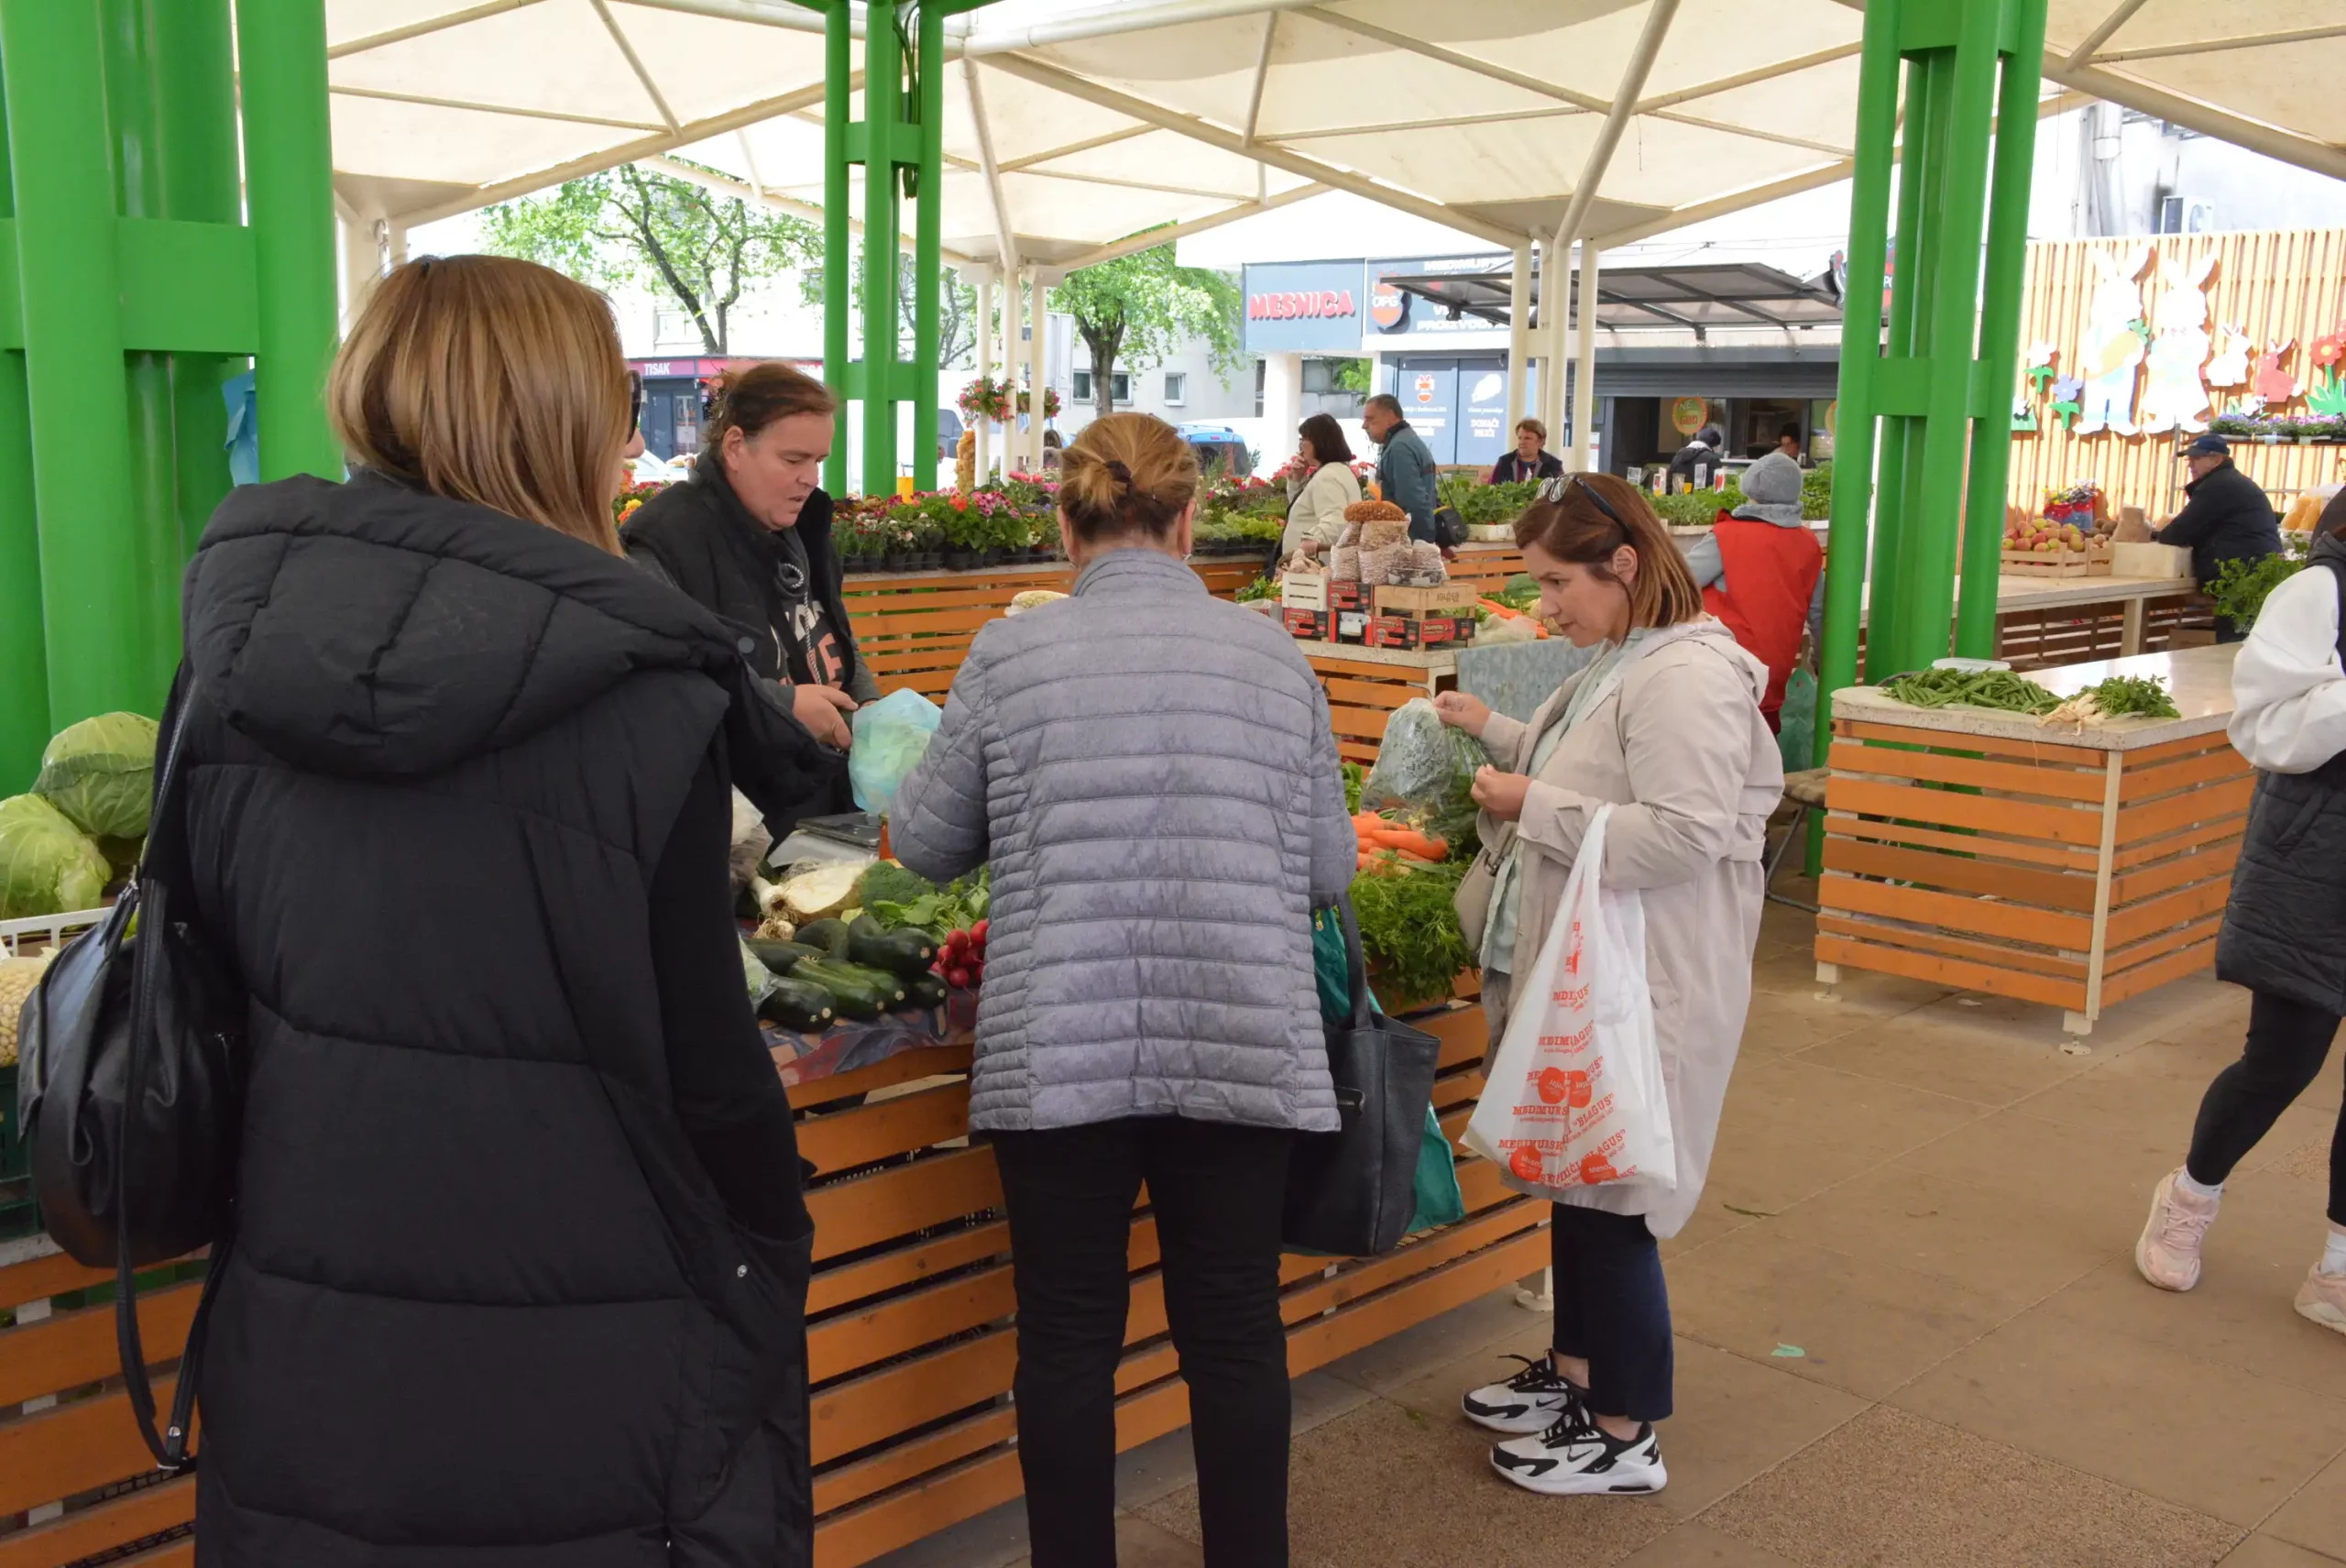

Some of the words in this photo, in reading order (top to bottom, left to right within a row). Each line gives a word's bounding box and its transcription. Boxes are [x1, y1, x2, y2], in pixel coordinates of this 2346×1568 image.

[1249, 290, 1355, 320] MESNICA
[1372, 295, 1399, 309] OPG
[644, 363, 671, 376] TISAK
